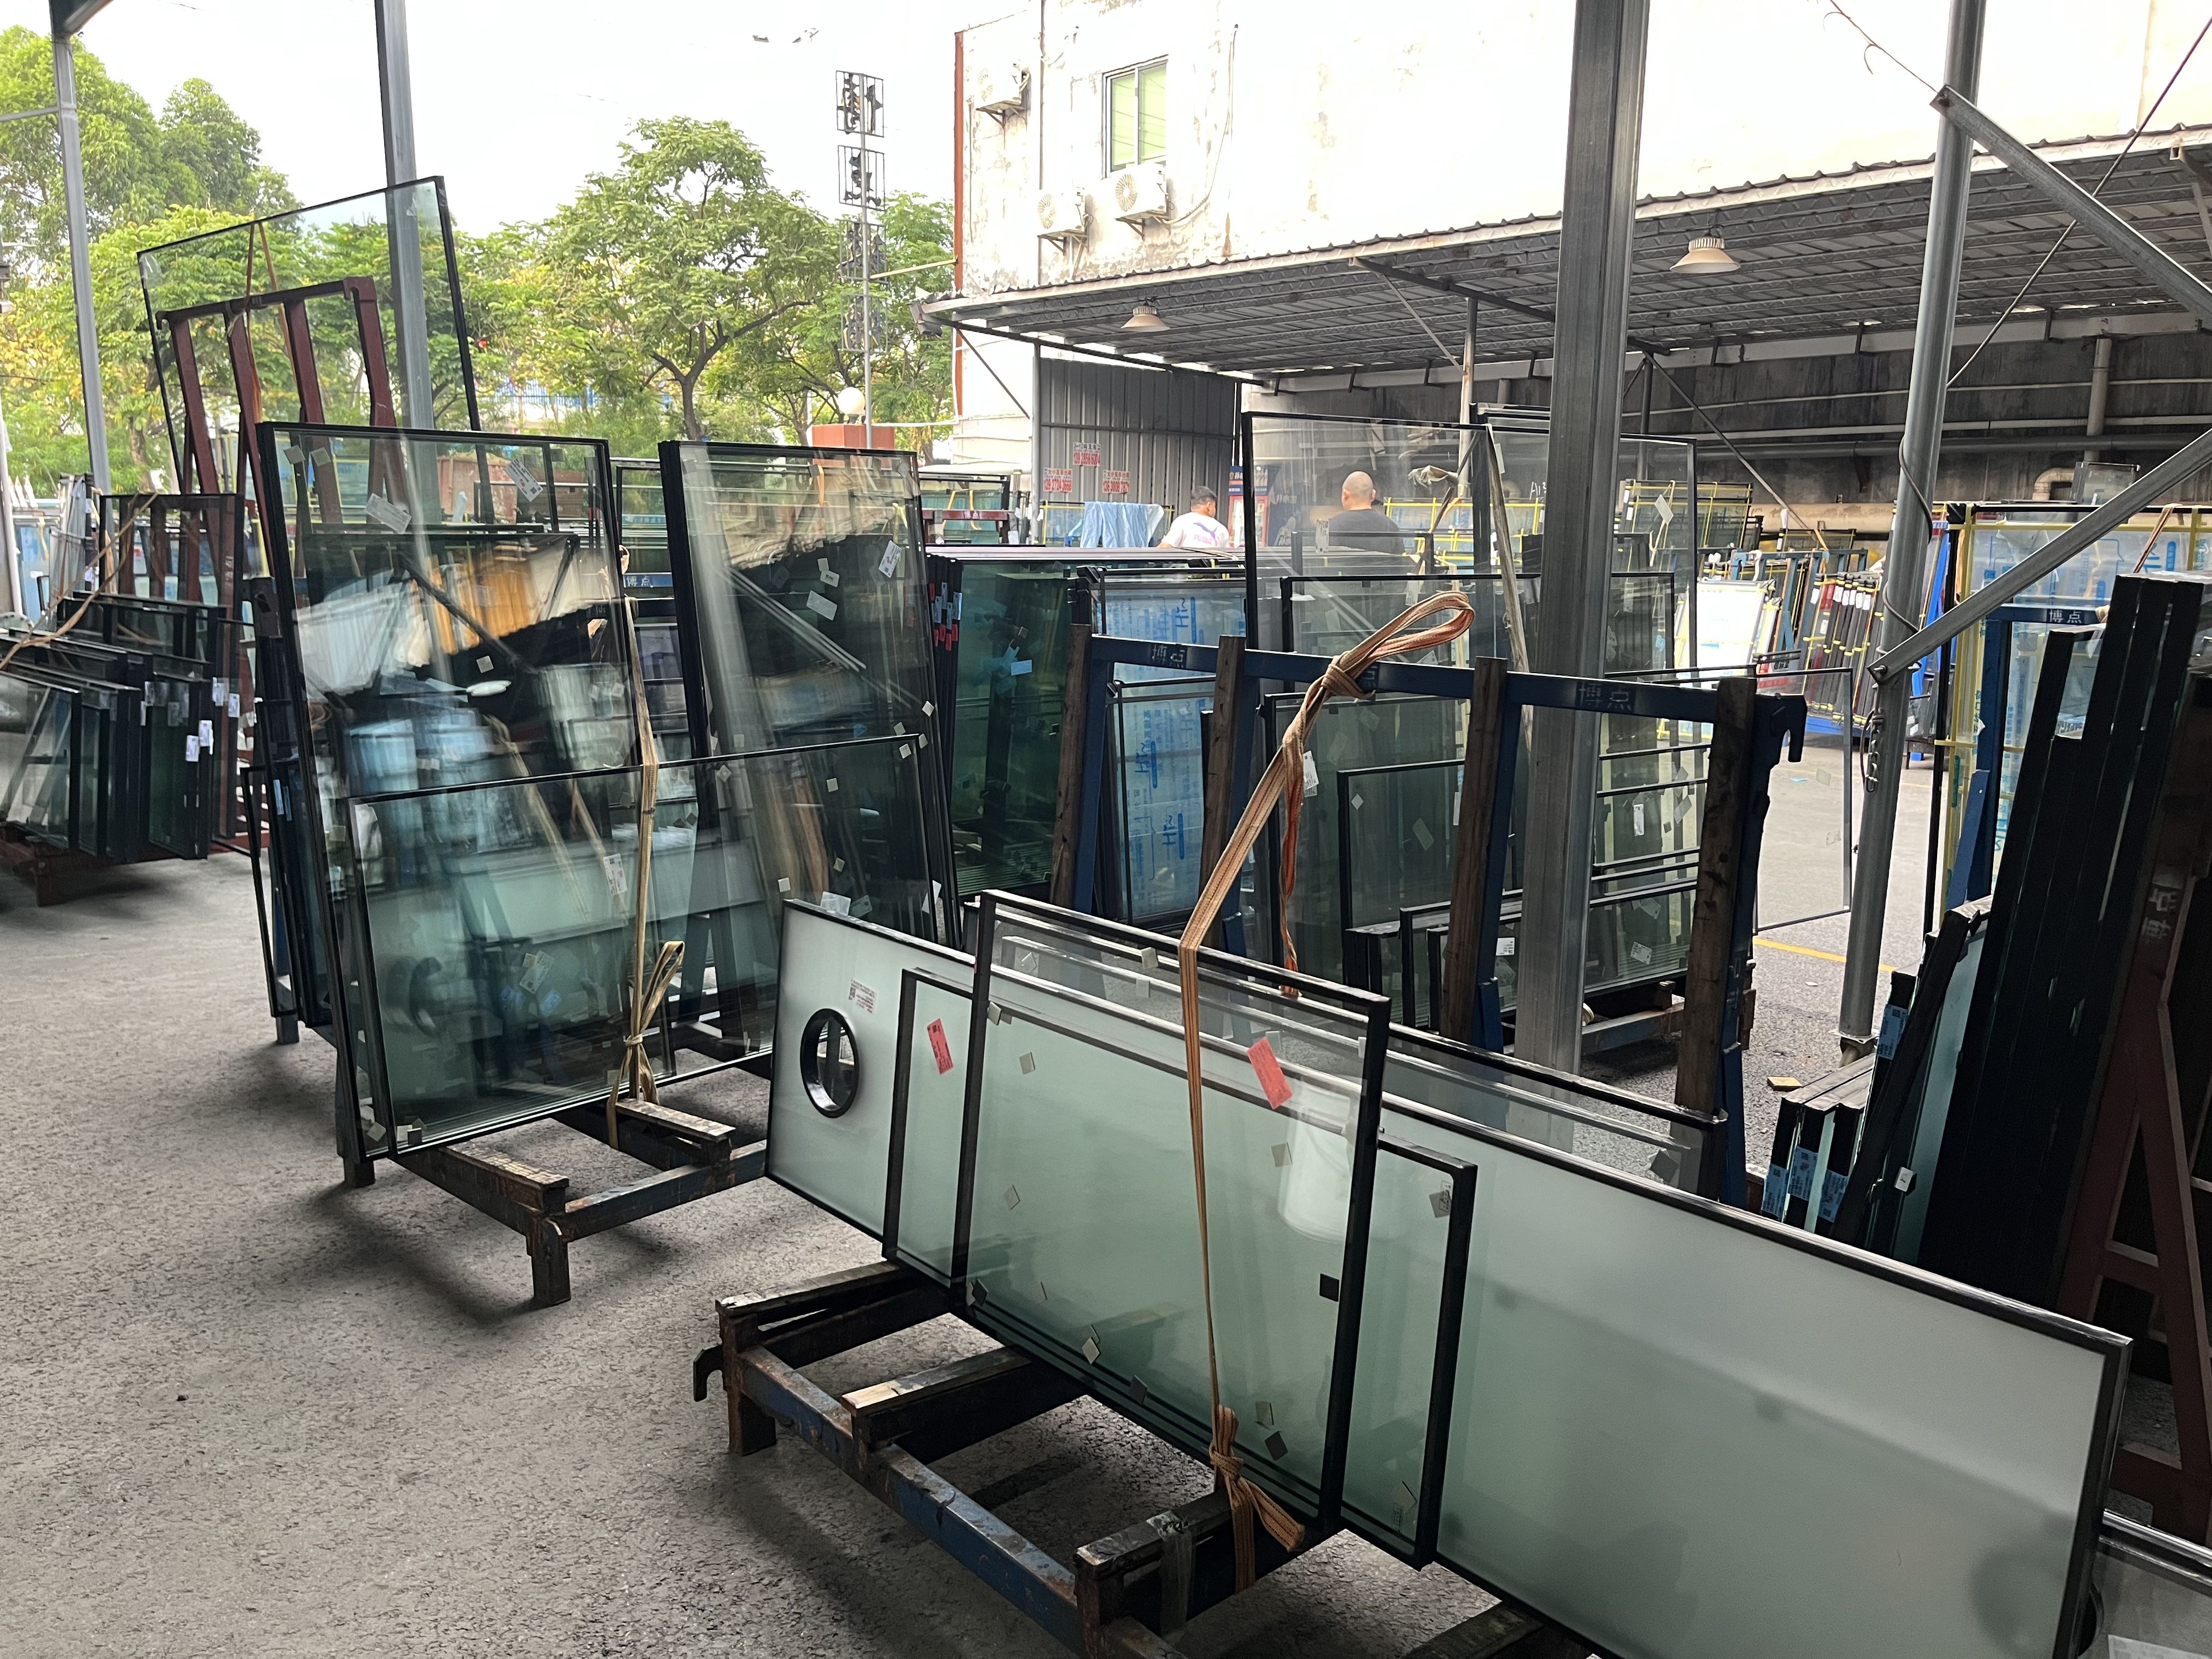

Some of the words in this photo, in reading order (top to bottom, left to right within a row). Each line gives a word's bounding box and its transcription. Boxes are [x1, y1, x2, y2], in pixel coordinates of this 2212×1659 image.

[626, 575, 652, 586] 博点
[2049, 609, 2082, 624] 博点
[1152, 644, 1185, 668] 博点
[1578, 681, 1632, 710] 博点
